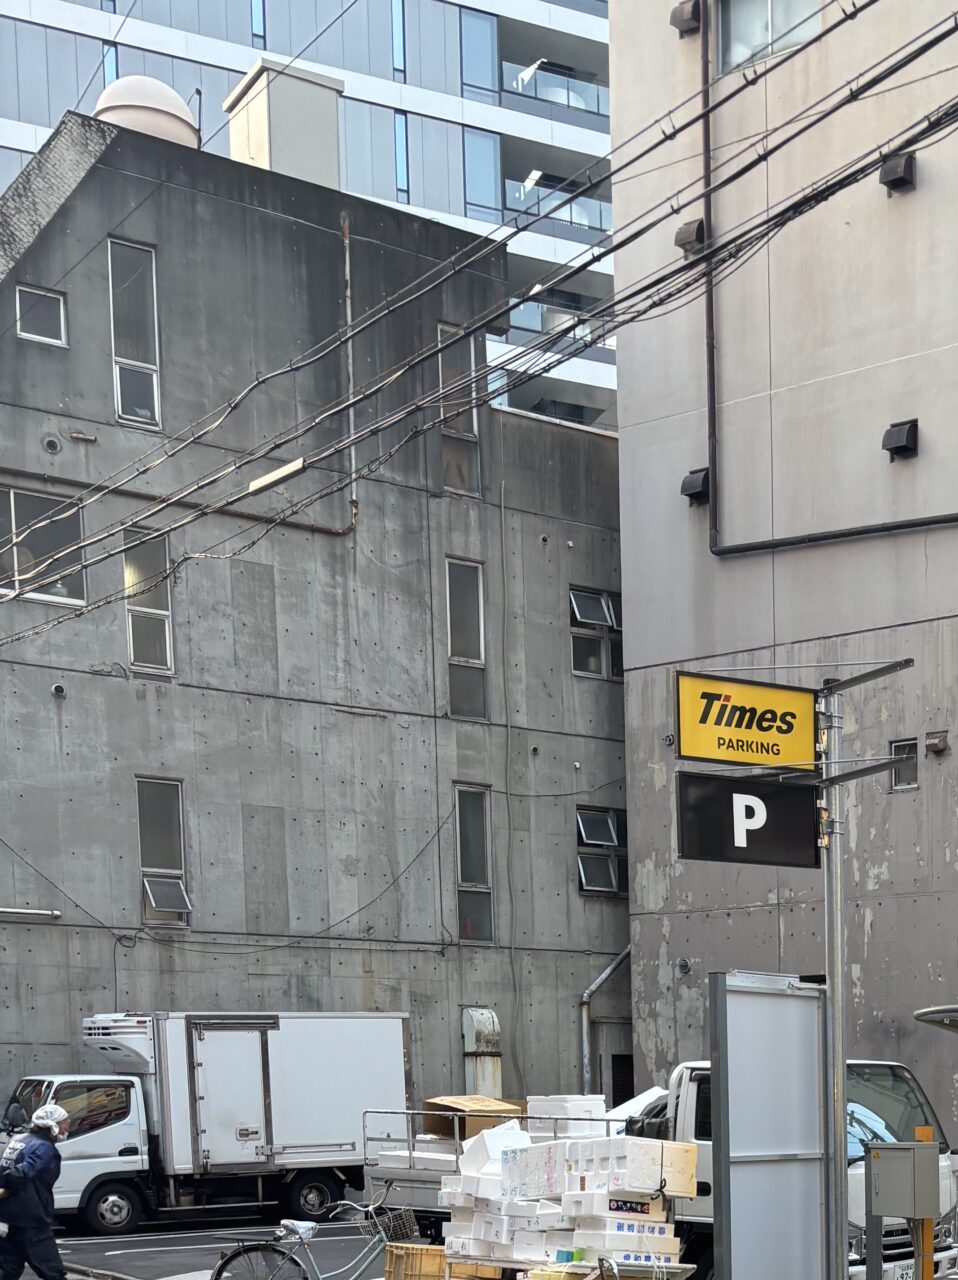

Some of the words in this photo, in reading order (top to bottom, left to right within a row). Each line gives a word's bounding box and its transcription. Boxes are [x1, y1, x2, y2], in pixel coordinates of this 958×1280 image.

[698, 691, 797, 735] Times
[717, 736, 781, 756] PARKING
[732, 792, 767, 848] P
